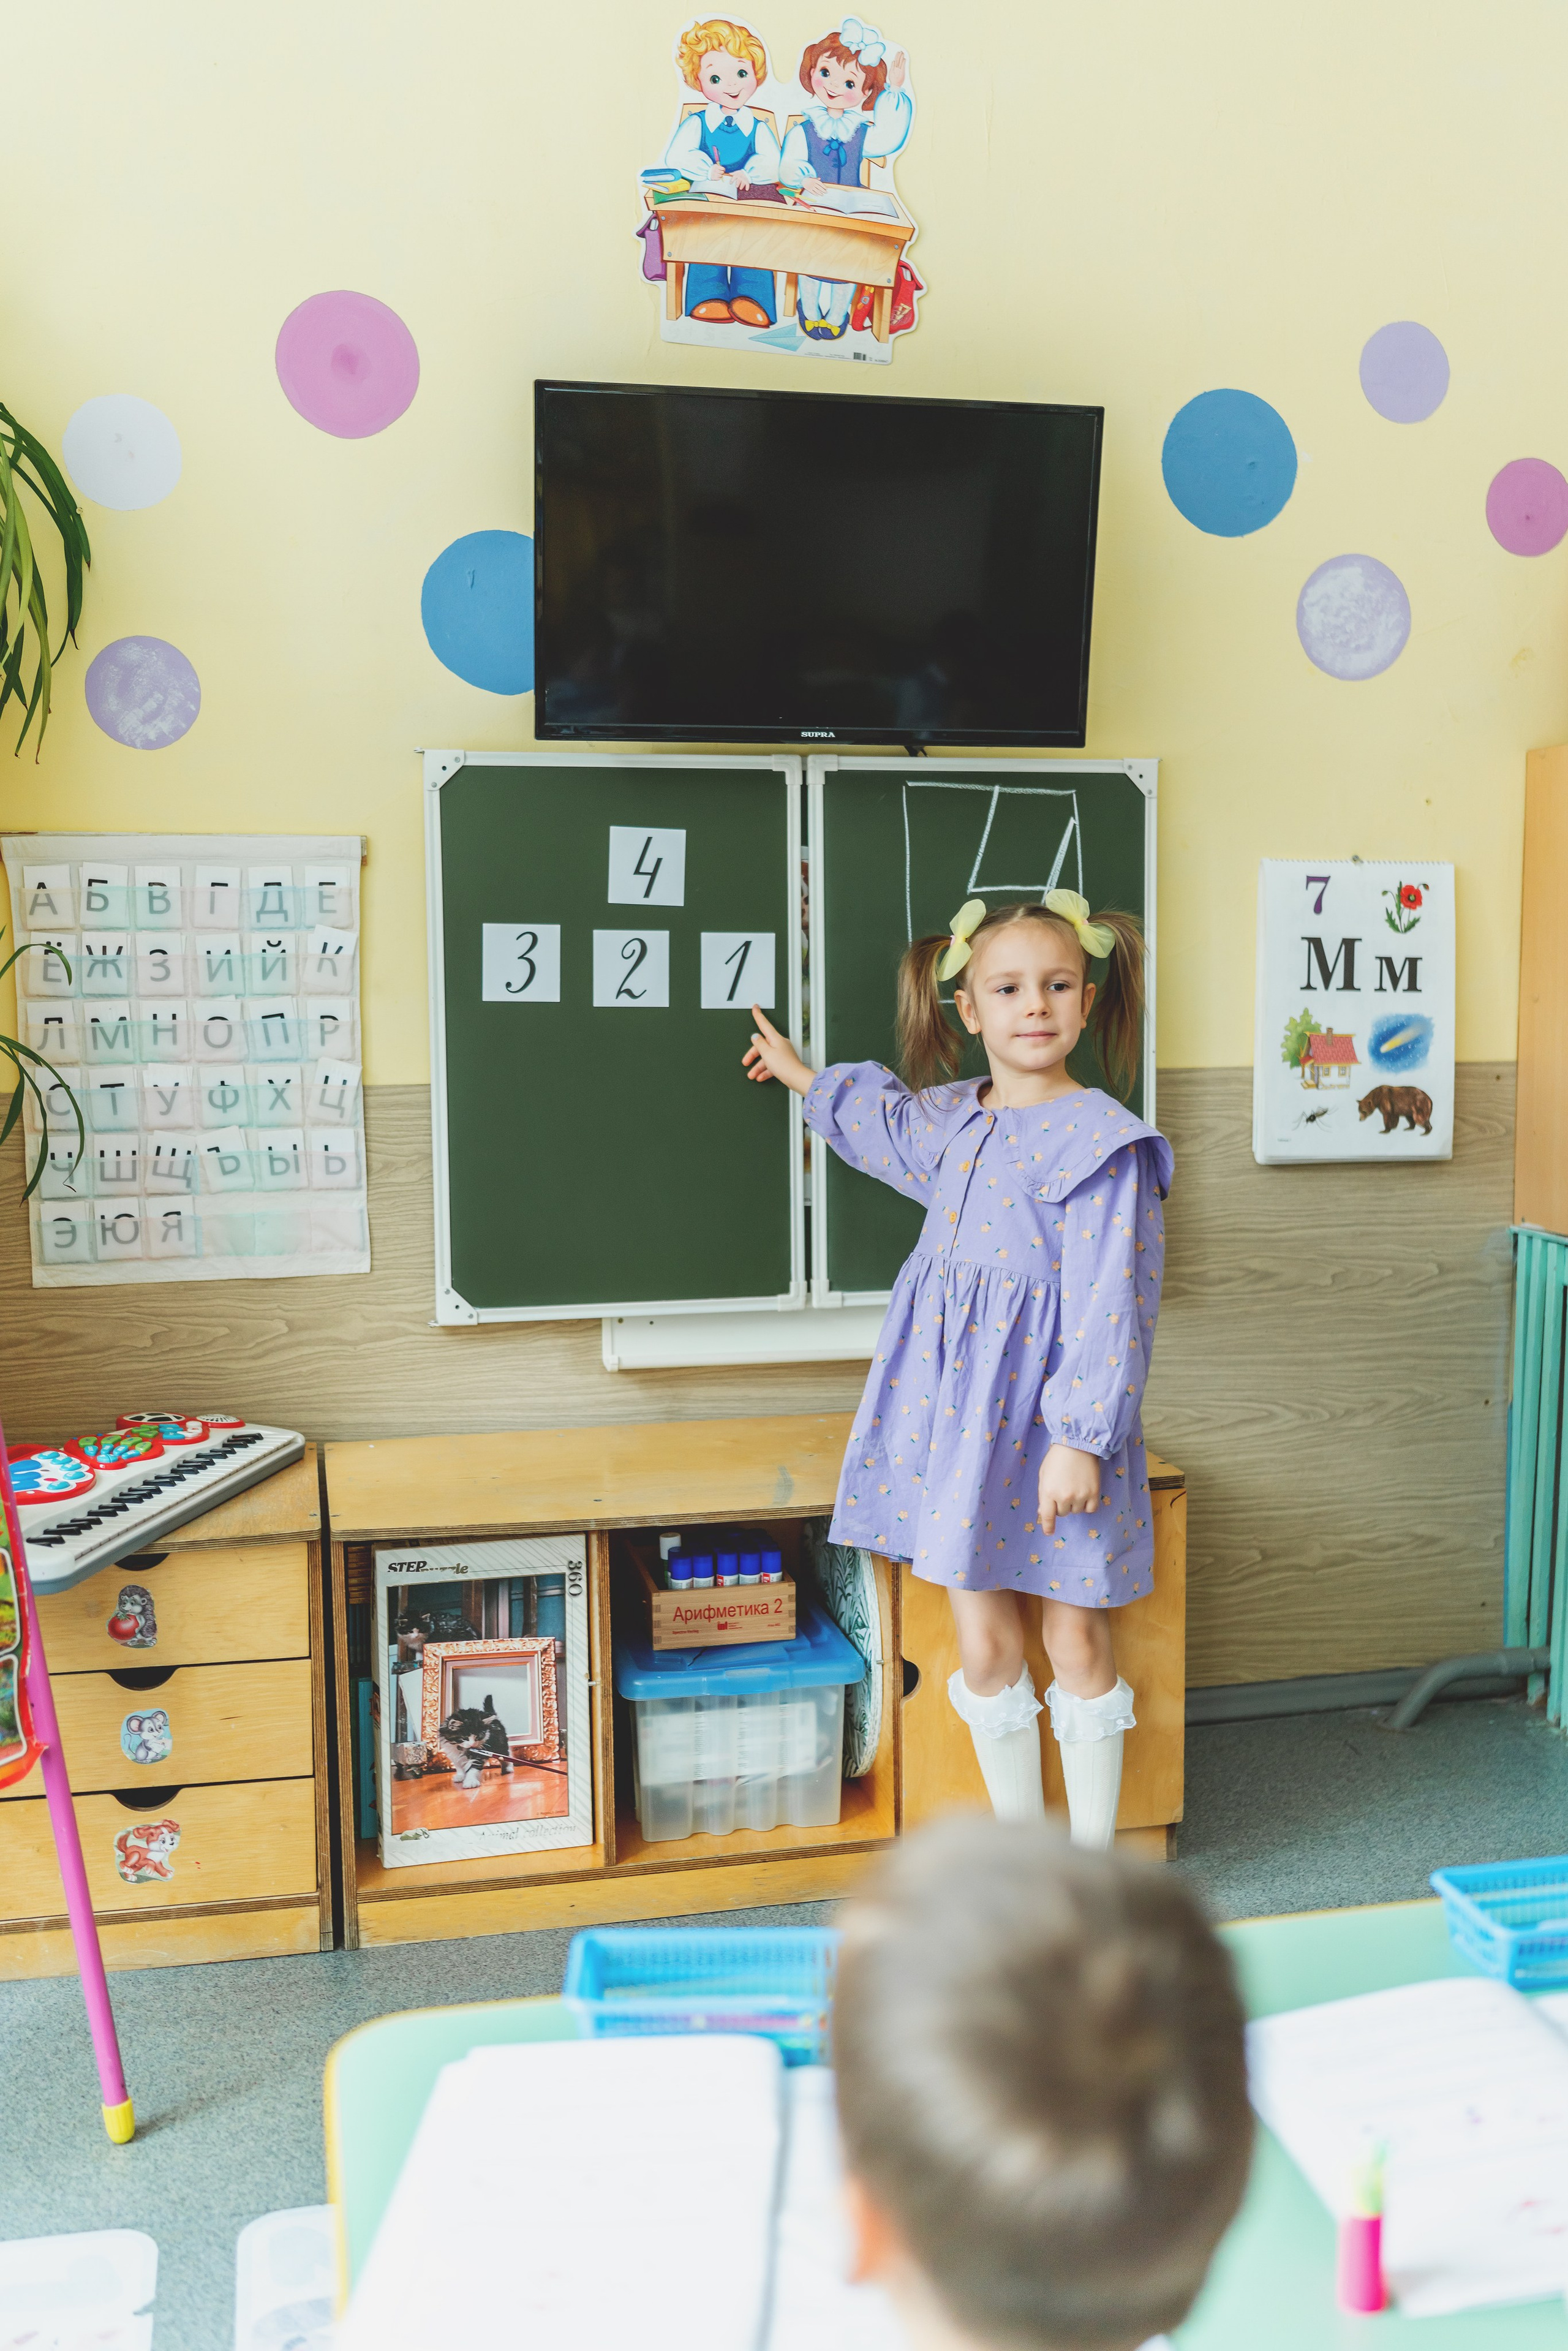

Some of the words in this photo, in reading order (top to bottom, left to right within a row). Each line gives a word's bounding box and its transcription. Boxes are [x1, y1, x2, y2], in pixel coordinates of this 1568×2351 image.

[633, 836, 663, 899] 4
[29, 881, 58, 916] А
[86, 878, 108, 913] Б
[148, 881, 172, 914] В
[210, 881, 228, 915] Г
[256, 882, 288, 923] Д
[318, 881, 337, 914] Е
[1306, 875, 1331, 914] 7
[43, 941, 62, 983] Ё
[86, 945, 123, 978] Ж
[150, 949, 172, 981] З
[207, 949, 234, 982] И
[262, 940, 287, 981] Й
[317, 942, 344, 977] К
[505, 931, 539, 994] 3
[616, 938, 647, 1000] 2
[725, 940, 752, 1002] 1
[1300, 937, 1362, 991] М
[37, 1017, 66, 1051] Л
[90, 1016, 130, 1050] М
[153, 1013, 177, 1046] Н
[203, 1016, 233, 1049] О
[262, 1013, 290, 1047] П
[320, 1015, 340, 1047] Р
[45, 1084, 70, 1116] С
[100, 1083, 125, 1116] Т
[153, 1082, 179, 1115] У
[208, 1081, 239, 1113] Ф
[268, 1078, 292, 1111] Х
[319, 1076, 347, 1118] Ц
[50, 1152, 72, 1184] Ч
[99, 1150, 137, 1182] Ш
[152, 1145, 192, 1188] Щ
[207, 1147, 241, 1176] Ъ
[269, 1144, 301, 1176] Ы
[324, 1145, 347, 1176] Ь
[54, 1217, 77, 1248] Э
[101, 1213, 139, 1245] Ю
[162, 1211, 184, 1243] Я
[388, 1561, 427, 1572] STEP
[568, 1560, 582, 1596] 360
[673, 1601, 769, 1625] Арифметика
[774, 1598, 783, 1613] 2
